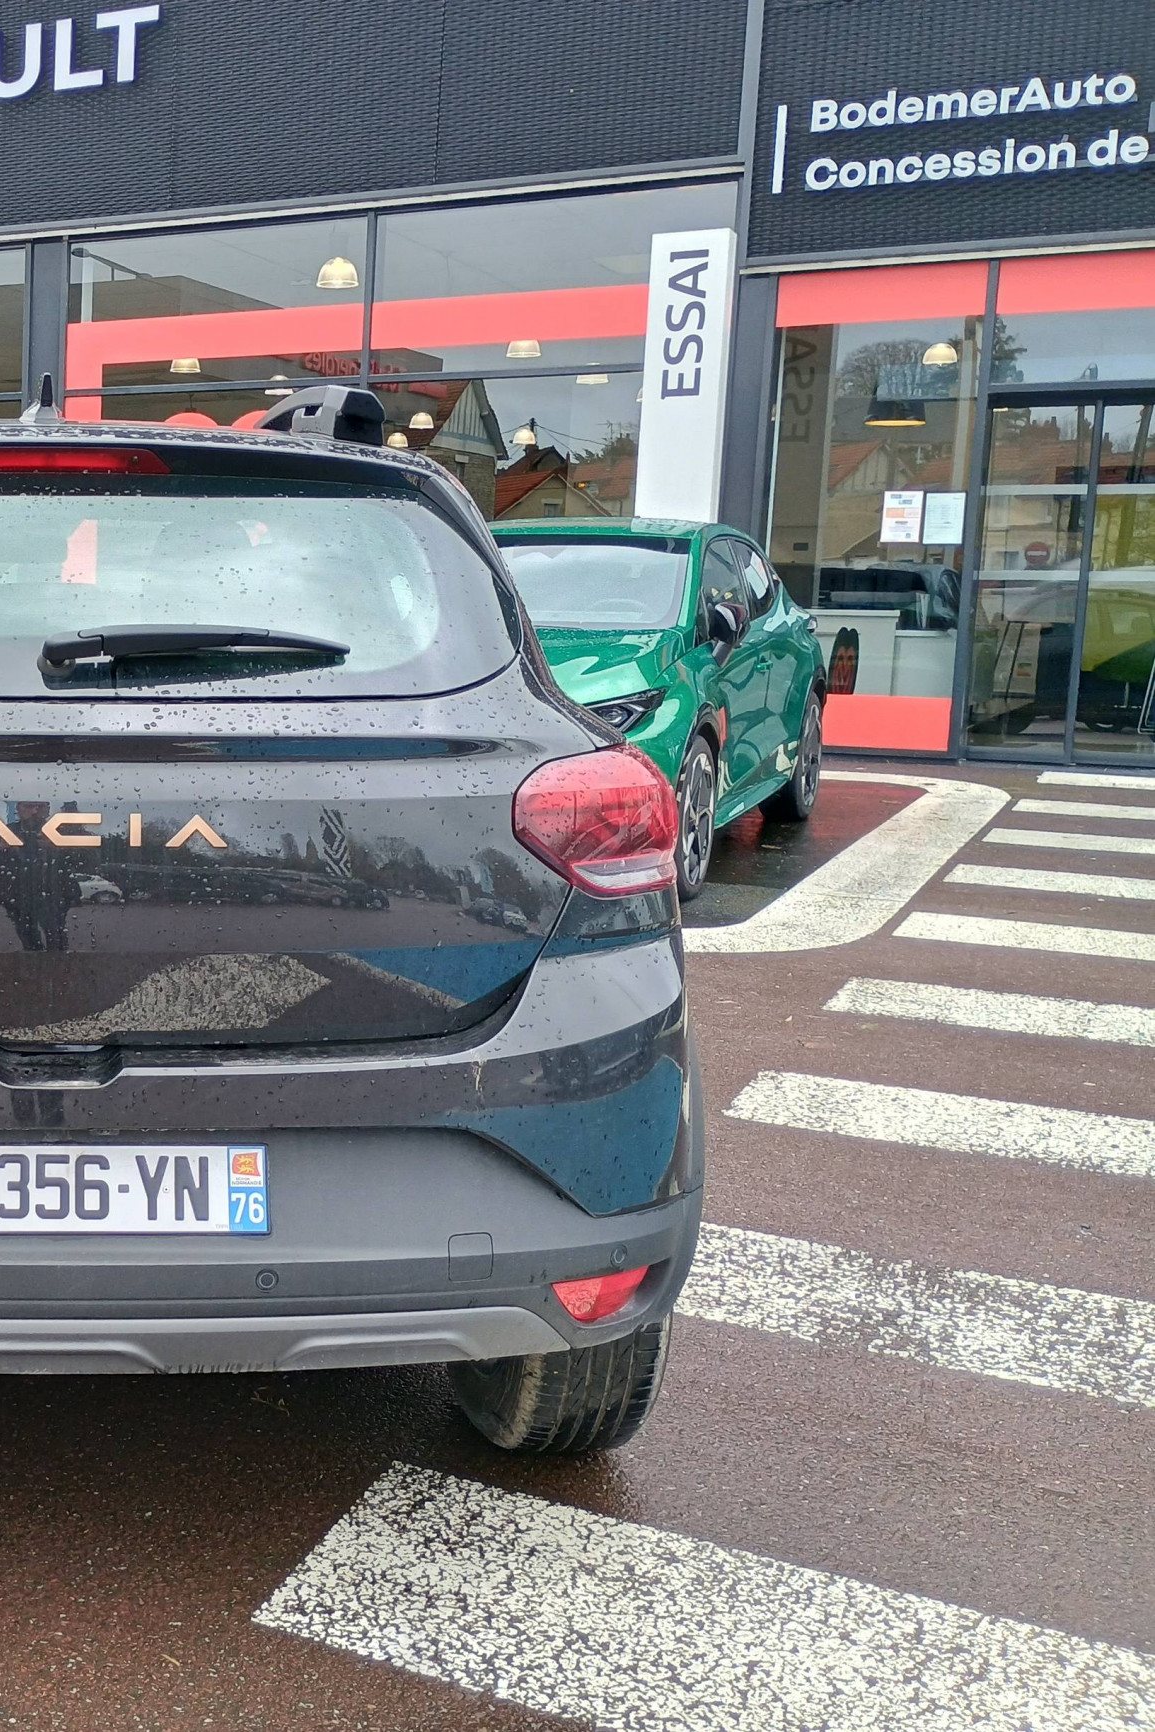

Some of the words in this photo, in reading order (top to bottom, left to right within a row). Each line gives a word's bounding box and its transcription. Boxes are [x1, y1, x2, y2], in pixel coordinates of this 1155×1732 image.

[810, 73, 1137, 132] BodemerAuto
[805, 137, 1077, 191] Concession
[1087, 129, 1149, 166] de
[661, 249, 710, 400] ESSAI
[230, 1191, 265, 1224] 76
